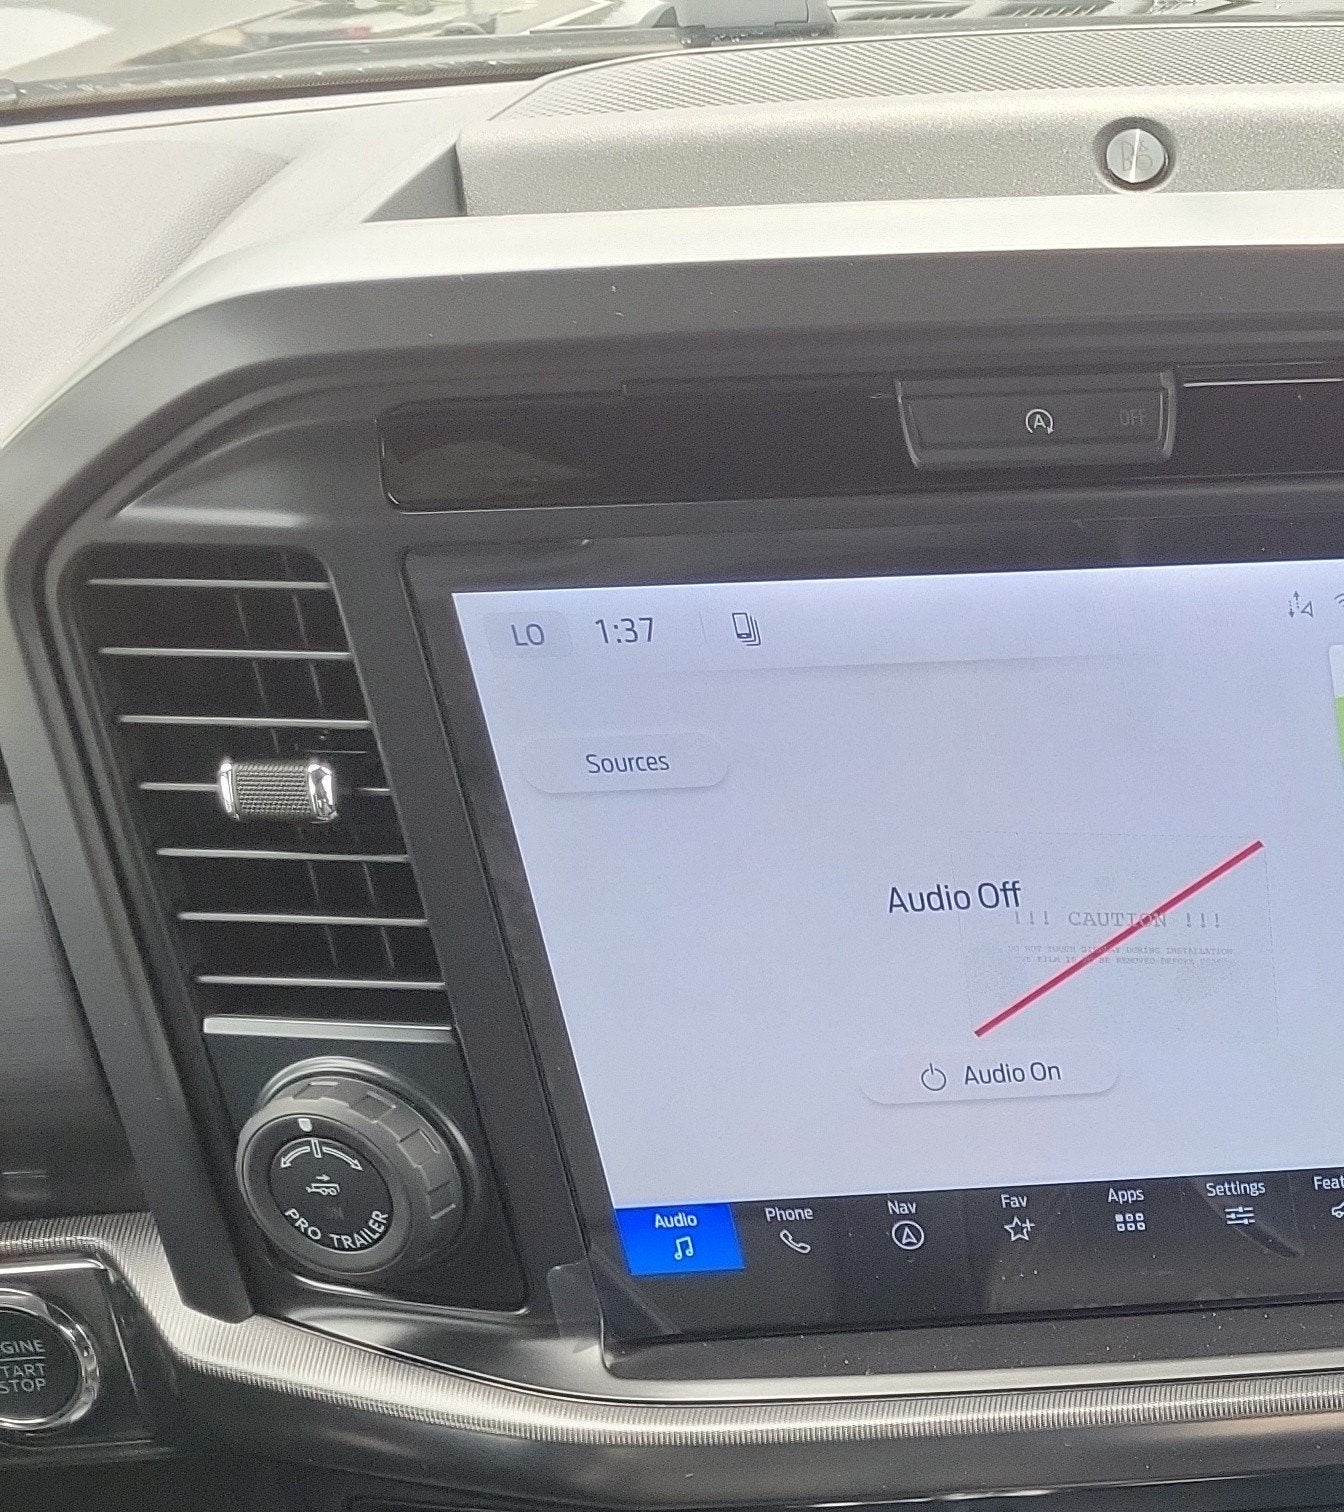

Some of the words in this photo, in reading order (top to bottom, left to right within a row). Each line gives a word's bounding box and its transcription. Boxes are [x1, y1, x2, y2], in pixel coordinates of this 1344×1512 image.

[1120, 409, 1147, 426] OFF
[511, 622, 546, 647] LO
[594, 616, 656, 646] 1:37
[585, 750, 671, 775] Sources
[888, 883, 972, 914] Audio
[977, 879, 1023, 910] Off
[1068, 911, 1168, 928] CAUTION
[963, 1062, 1026, 1087] Audio
[1030, 1061, 1062, 1083] On
[1107, 1187, 1145, 1206] Apps
[1205, 1179, 1266, 1199] Settings
[888, 1199, 918, 1216] Nav
[1001, 1193, 1029, 1210] Fav
[654, 1211, 698, 1229] Audio
[764, 1204, 814, 1222] Phone
[285, 1208, 322, 1240] PRO
[328, 1210, 389, 1249] TRAILER
[0, 1363, 47, 1377] TART
